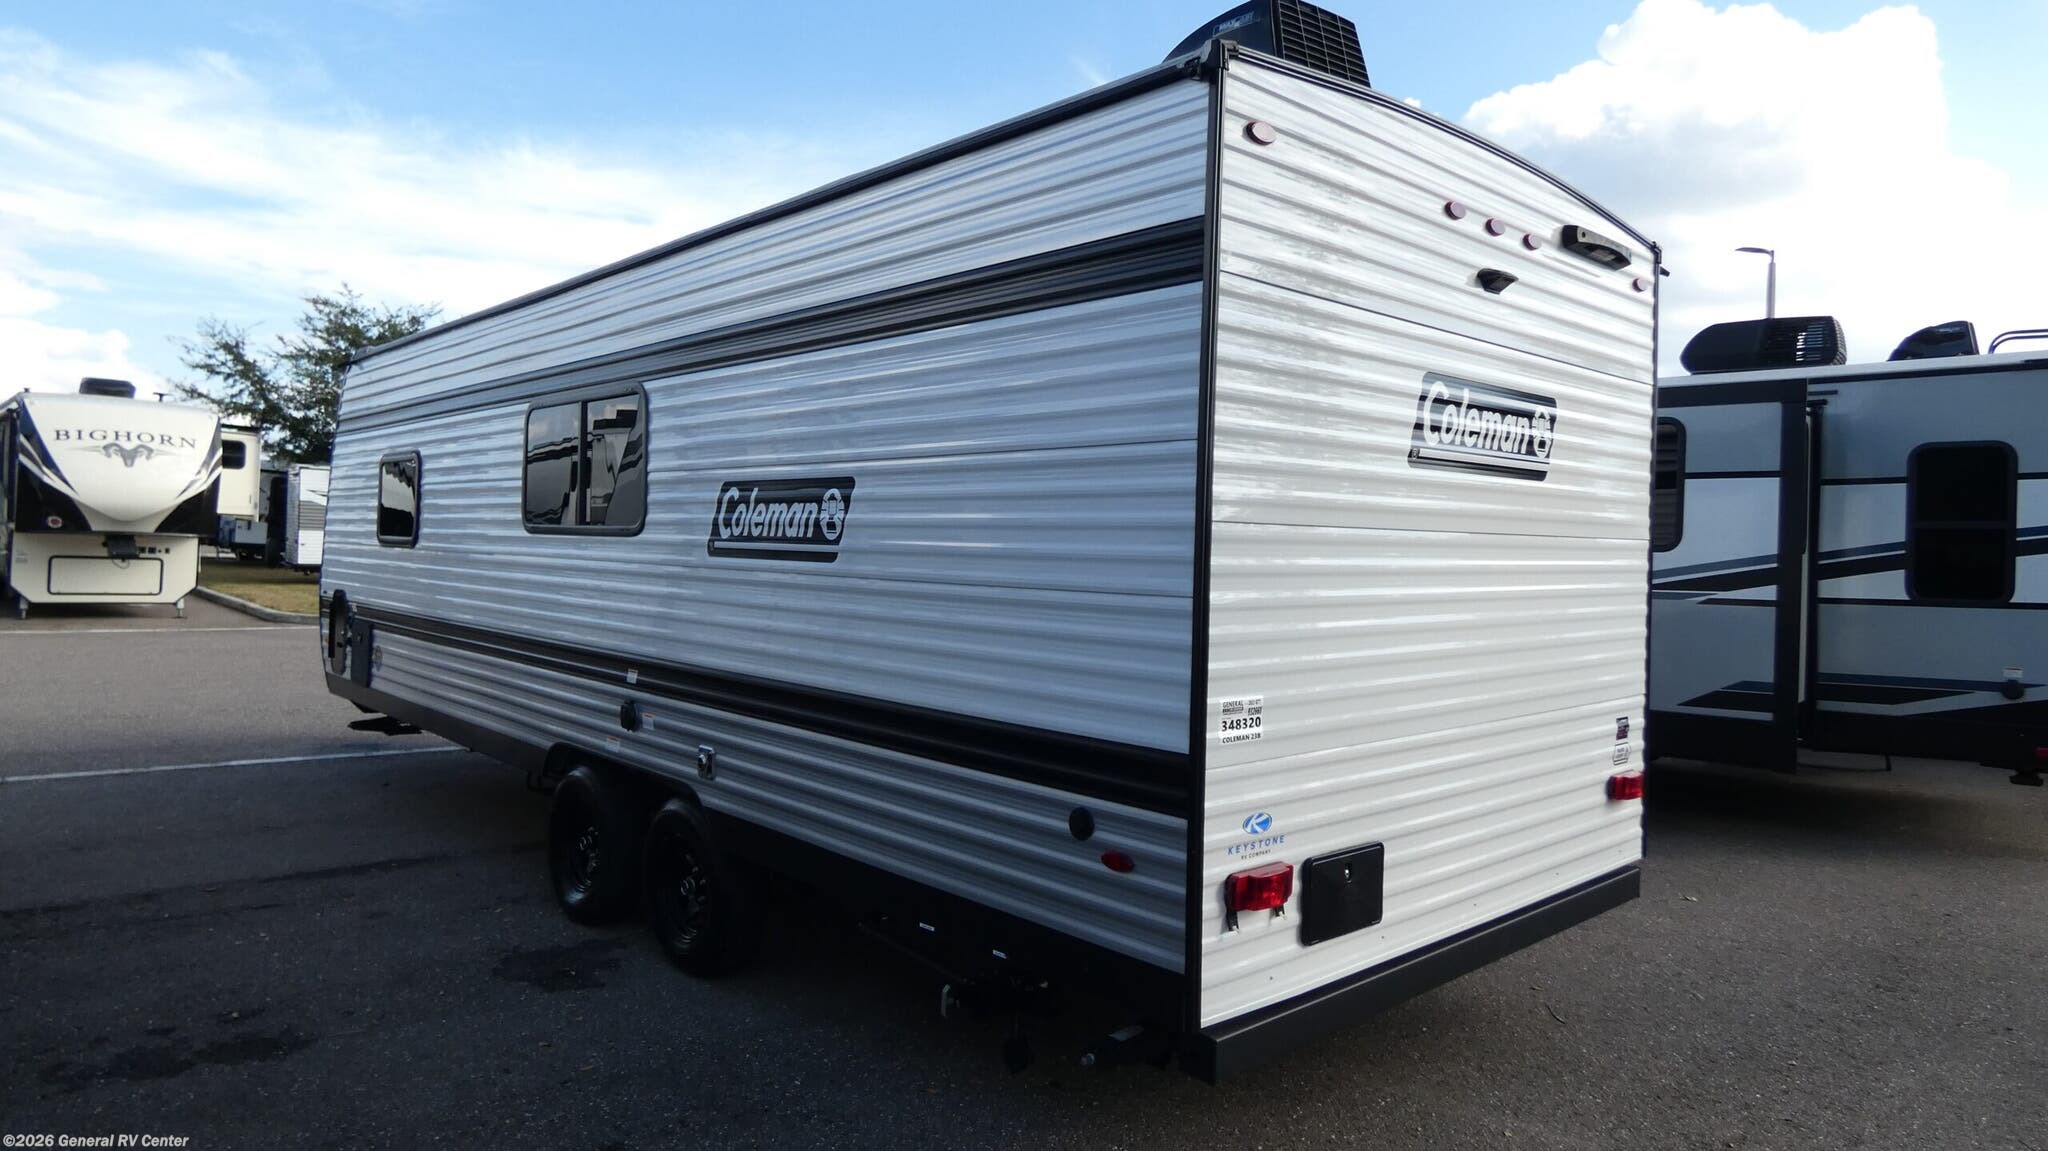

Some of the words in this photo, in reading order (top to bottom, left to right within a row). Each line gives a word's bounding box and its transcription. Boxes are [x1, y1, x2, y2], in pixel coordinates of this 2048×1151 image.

[1422, 380, 1530, 455] Coleman
[53, 428, 197, 449] BIGHORN
[717, 486, 819, 539] Coleman
[1221, 716, 1262, 732] 348320
[1222, 734, 1250, 744] COLEMAN
[1227, 834, 1285, 856] KEYSTONE
